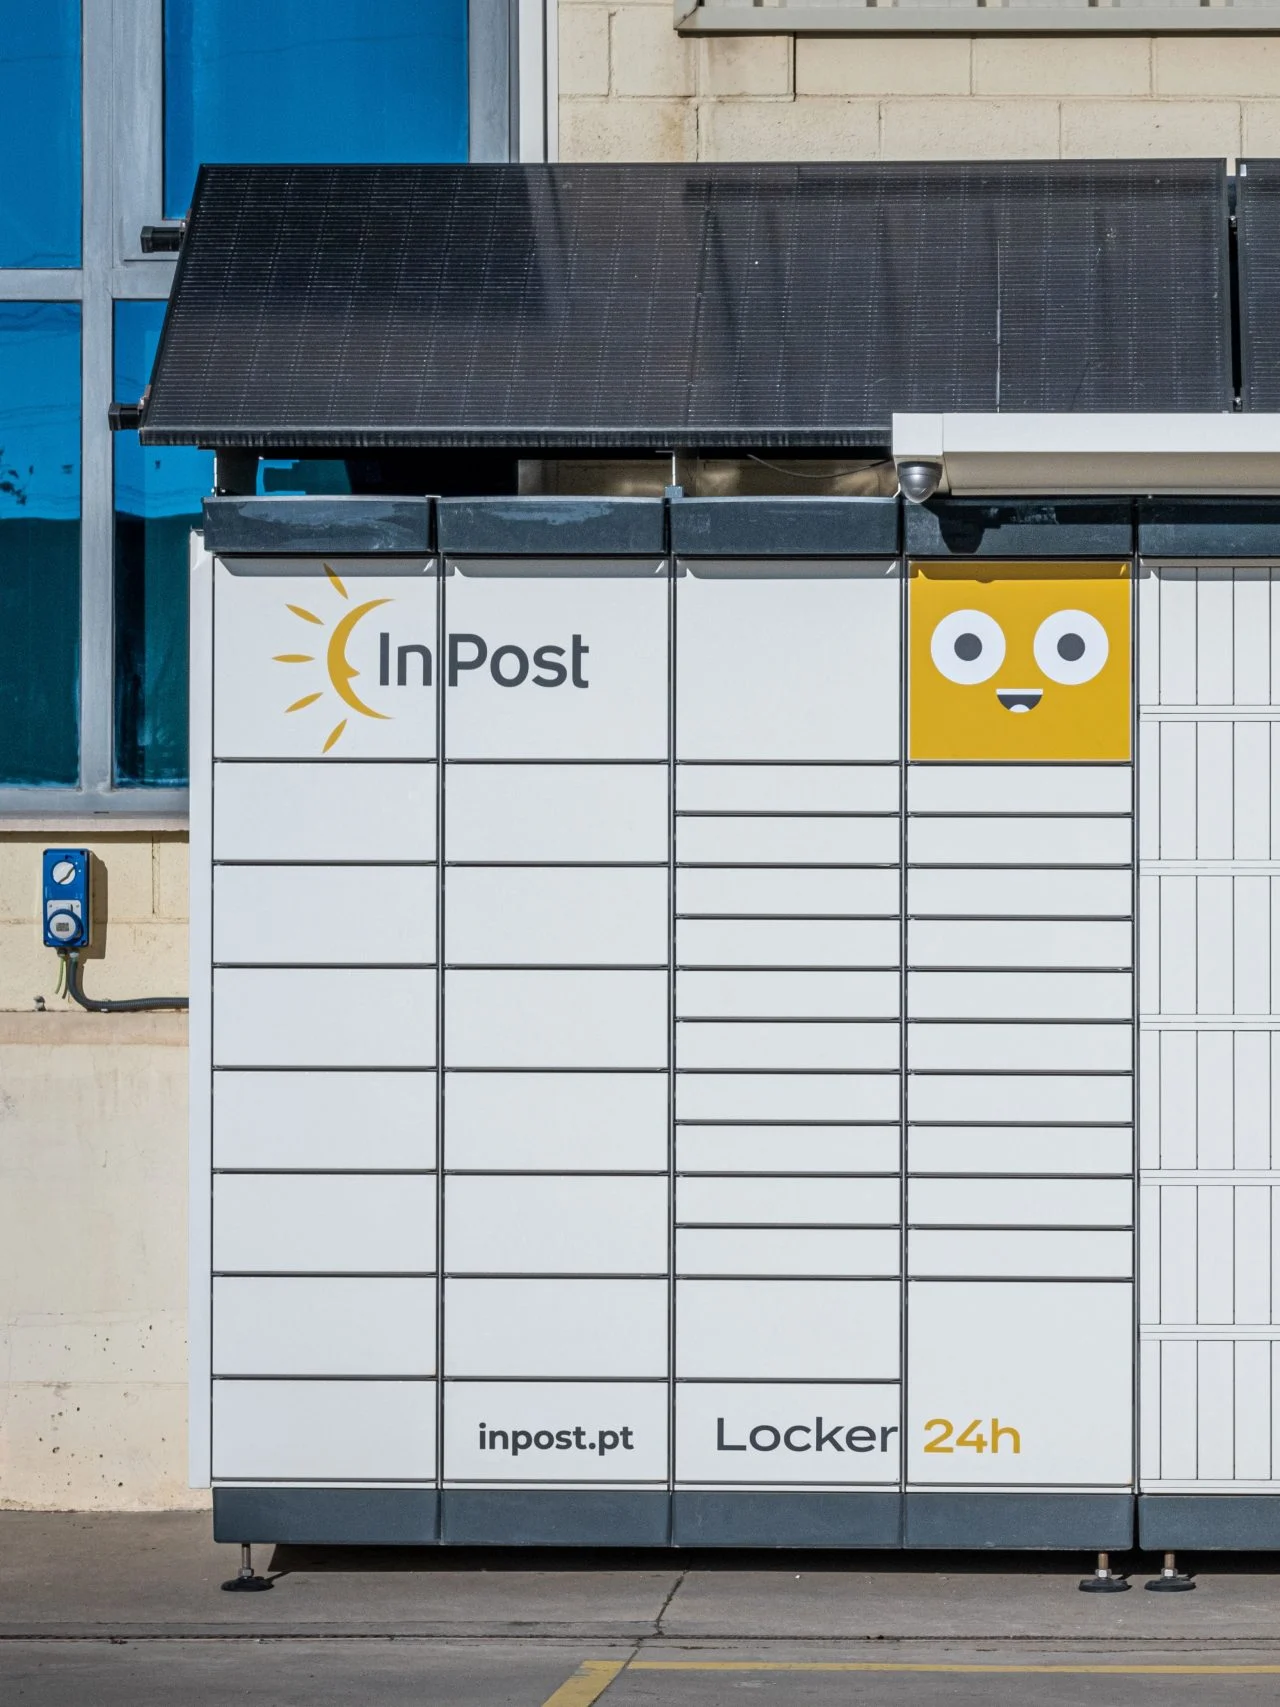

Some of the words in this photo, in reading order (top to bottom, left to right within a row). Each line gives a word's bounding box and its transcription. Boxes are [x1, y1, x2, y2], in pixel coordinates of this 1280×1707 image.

[379, 631, 590, 689] InPost
[478, 1421, 634, 1456] inpost.pt
[716, 1416, 898, 1454] Locker
[923, 1417, 1021, 1454] 24h
